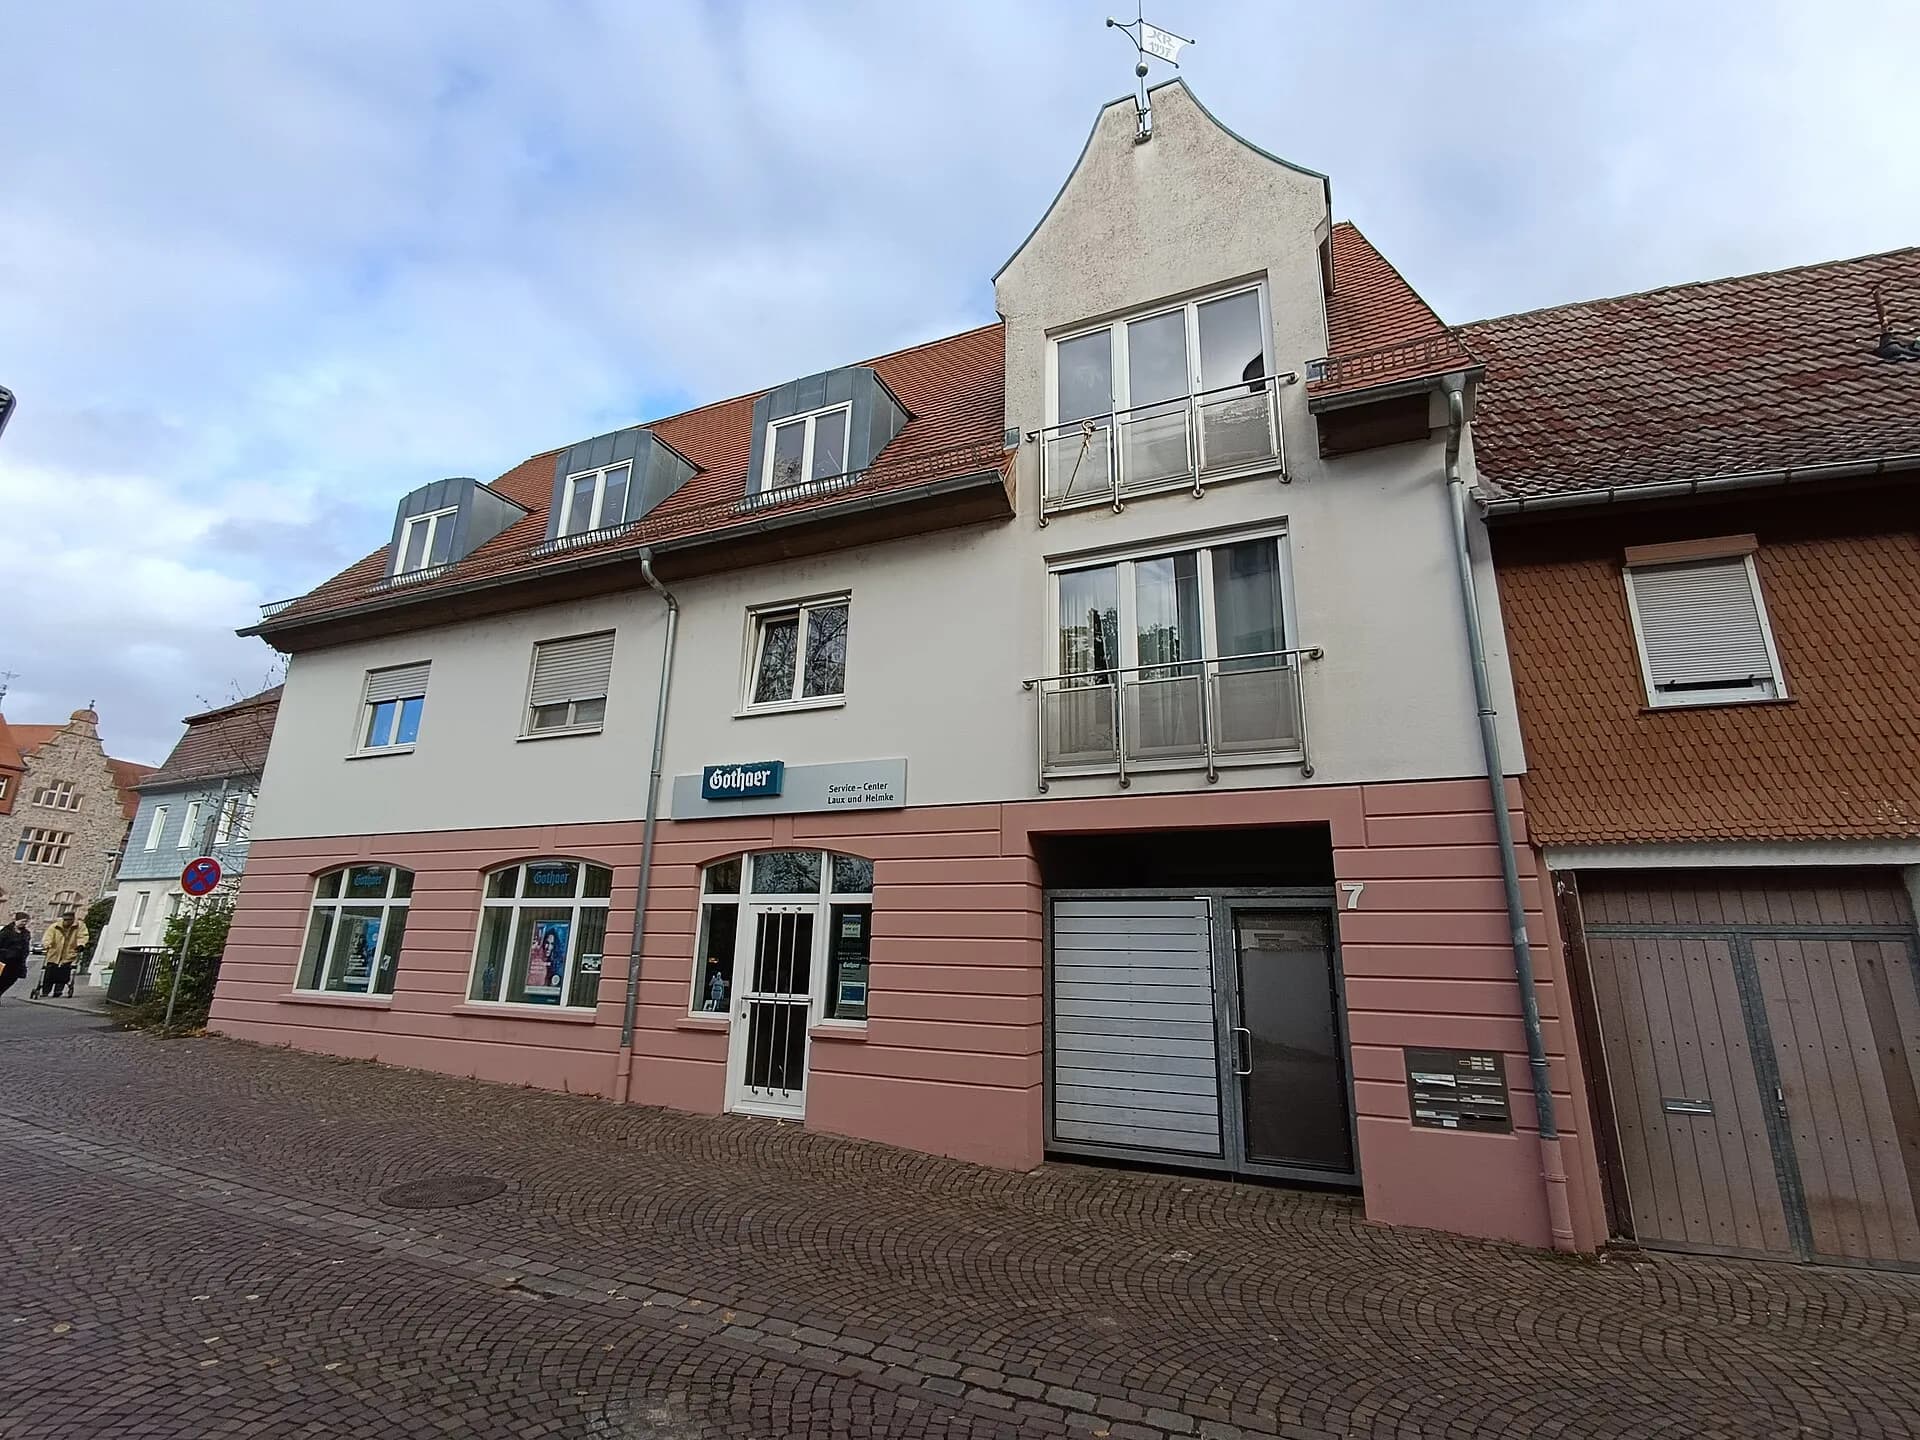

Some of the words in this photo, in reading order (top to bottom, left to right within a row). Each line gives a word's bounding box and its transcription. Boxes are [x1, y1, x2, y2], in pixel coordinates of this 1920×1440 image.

[710, 766, 771, 792] Gothaer
[828, 796, 846, 804] Laux
[848, 795, 862, 803] und
[534, 871, 570, 886] Gothaer
[1341, 882, 1364, 909] 7
